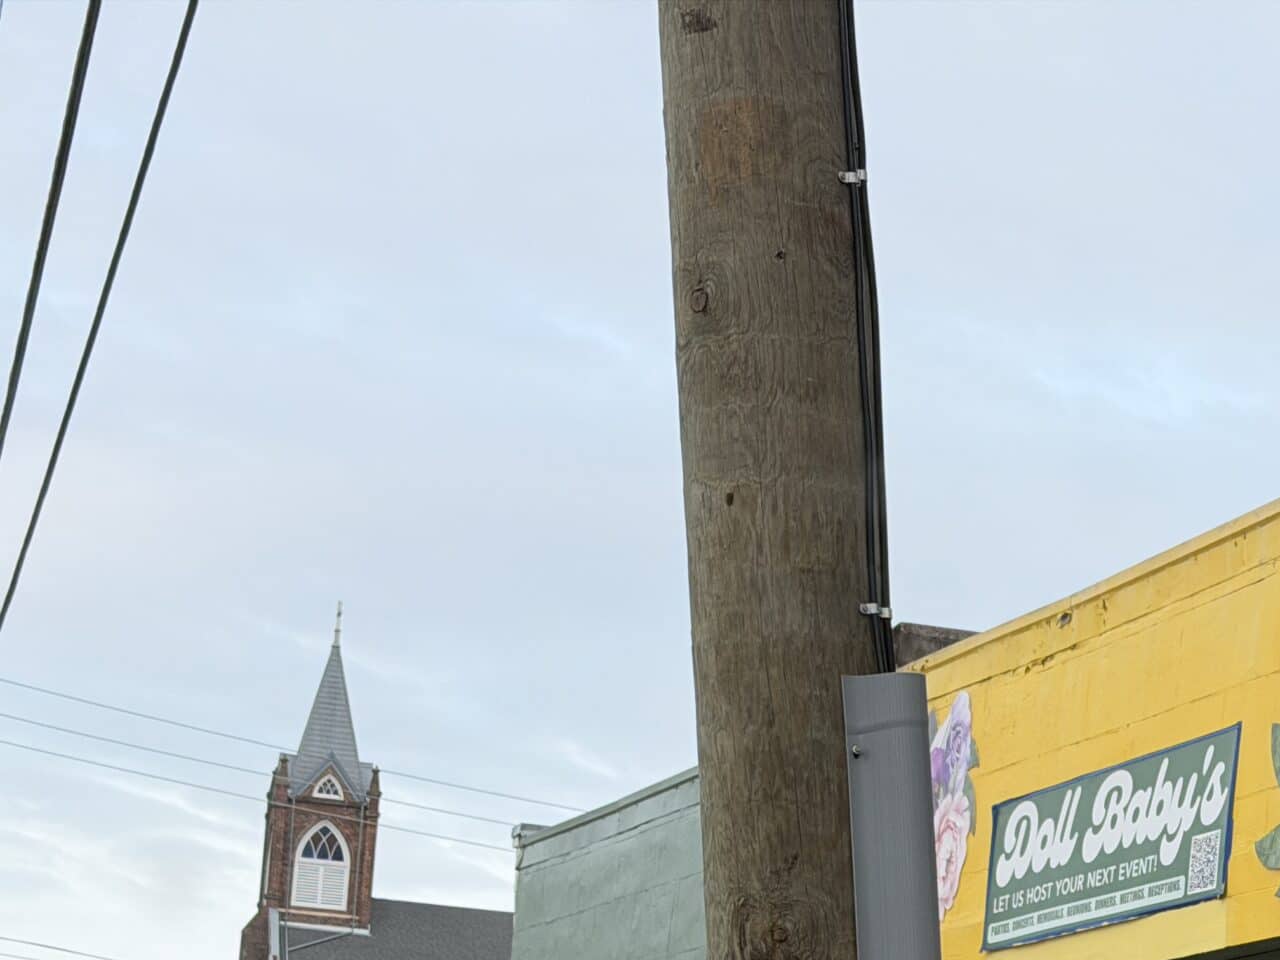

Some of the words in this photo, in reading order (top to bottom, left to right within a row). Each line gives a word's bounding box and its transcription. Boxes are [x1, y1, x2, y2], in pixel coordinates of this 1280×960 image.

[995, 785, 1082, 888] Doll
[1082, 744, 1228, 867] Baby's
[993, 896, 1009, 914] LET
[1011, 891, 1024, 910] US
[1026, 883, 1052, 906] HOST
[1055, 874, 1085, 897] YOUR
[1087, 867, 1116, 889] NEXT
[1119, 855, 1157, 882] EVENT!
